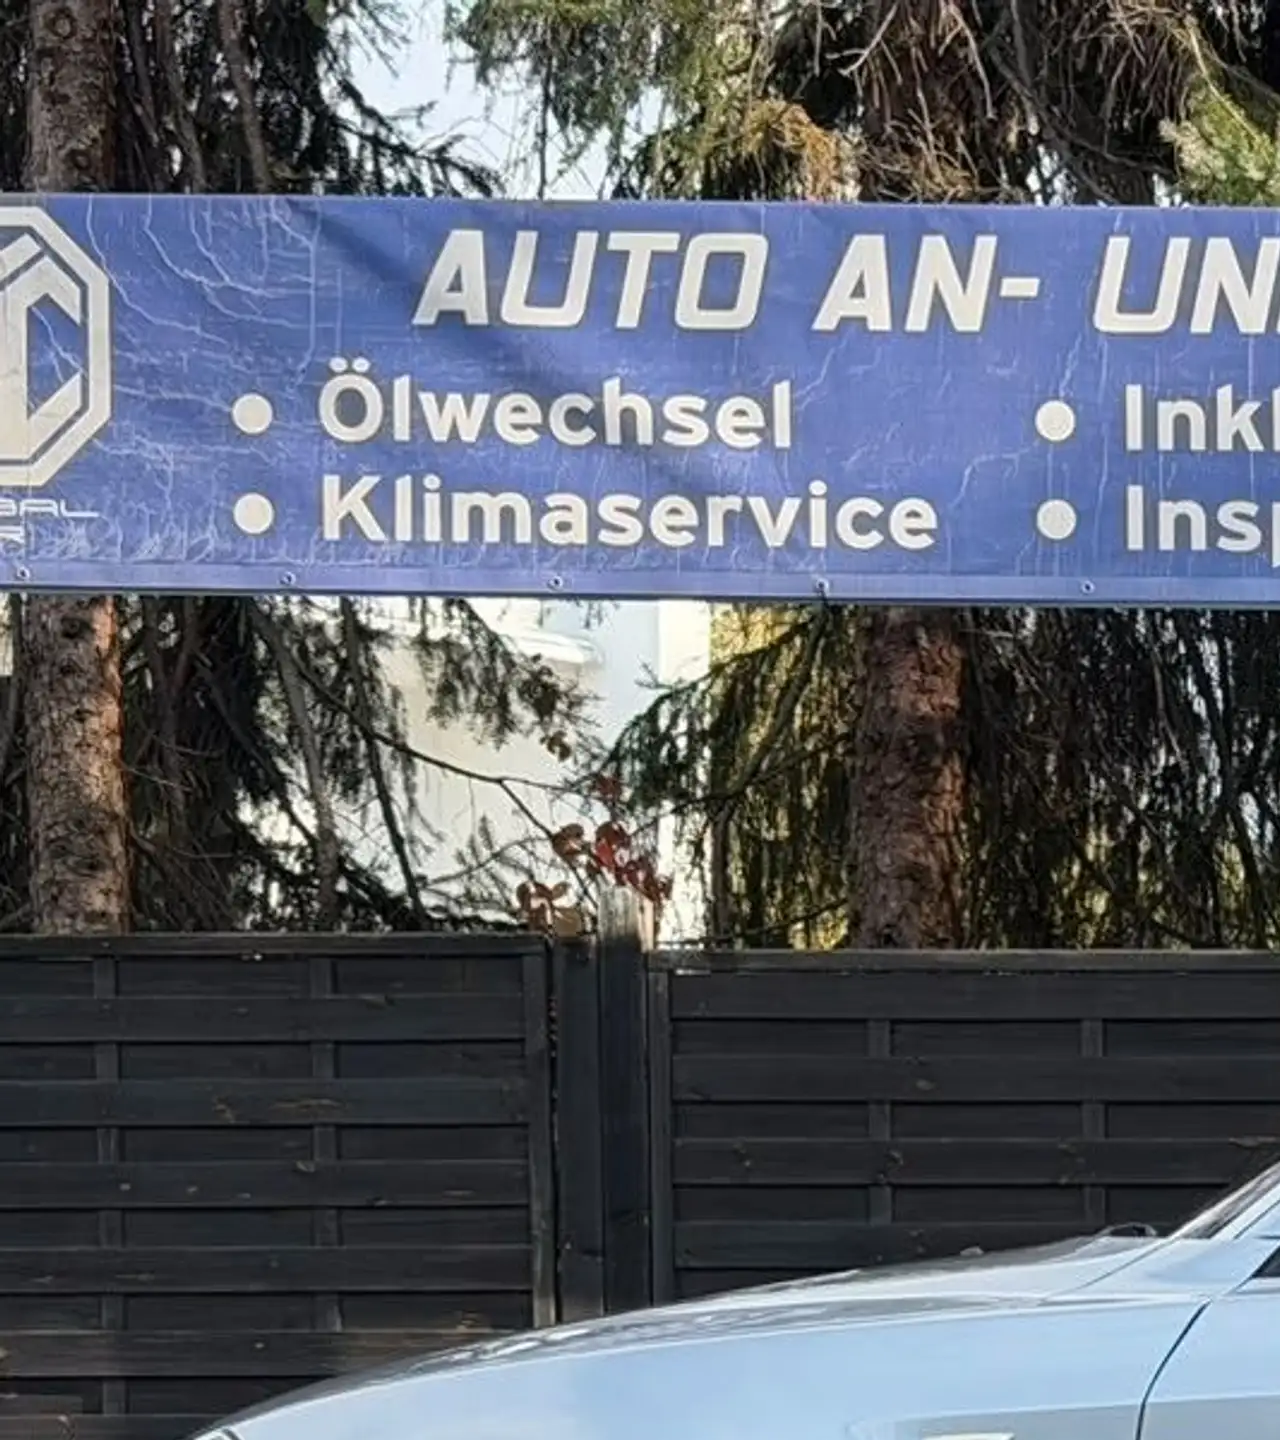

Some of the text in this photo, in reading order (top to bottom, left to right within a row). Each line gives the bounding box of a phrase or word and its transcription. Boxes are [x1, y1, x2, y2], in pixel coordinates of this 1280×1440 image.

[413, 229, 768, 330] AUTO
[812, 234, 1040, 333] AN-
[318, 356, 792, 449] Ölwechsel
[322, 473, 938, 549] Klimaservice
